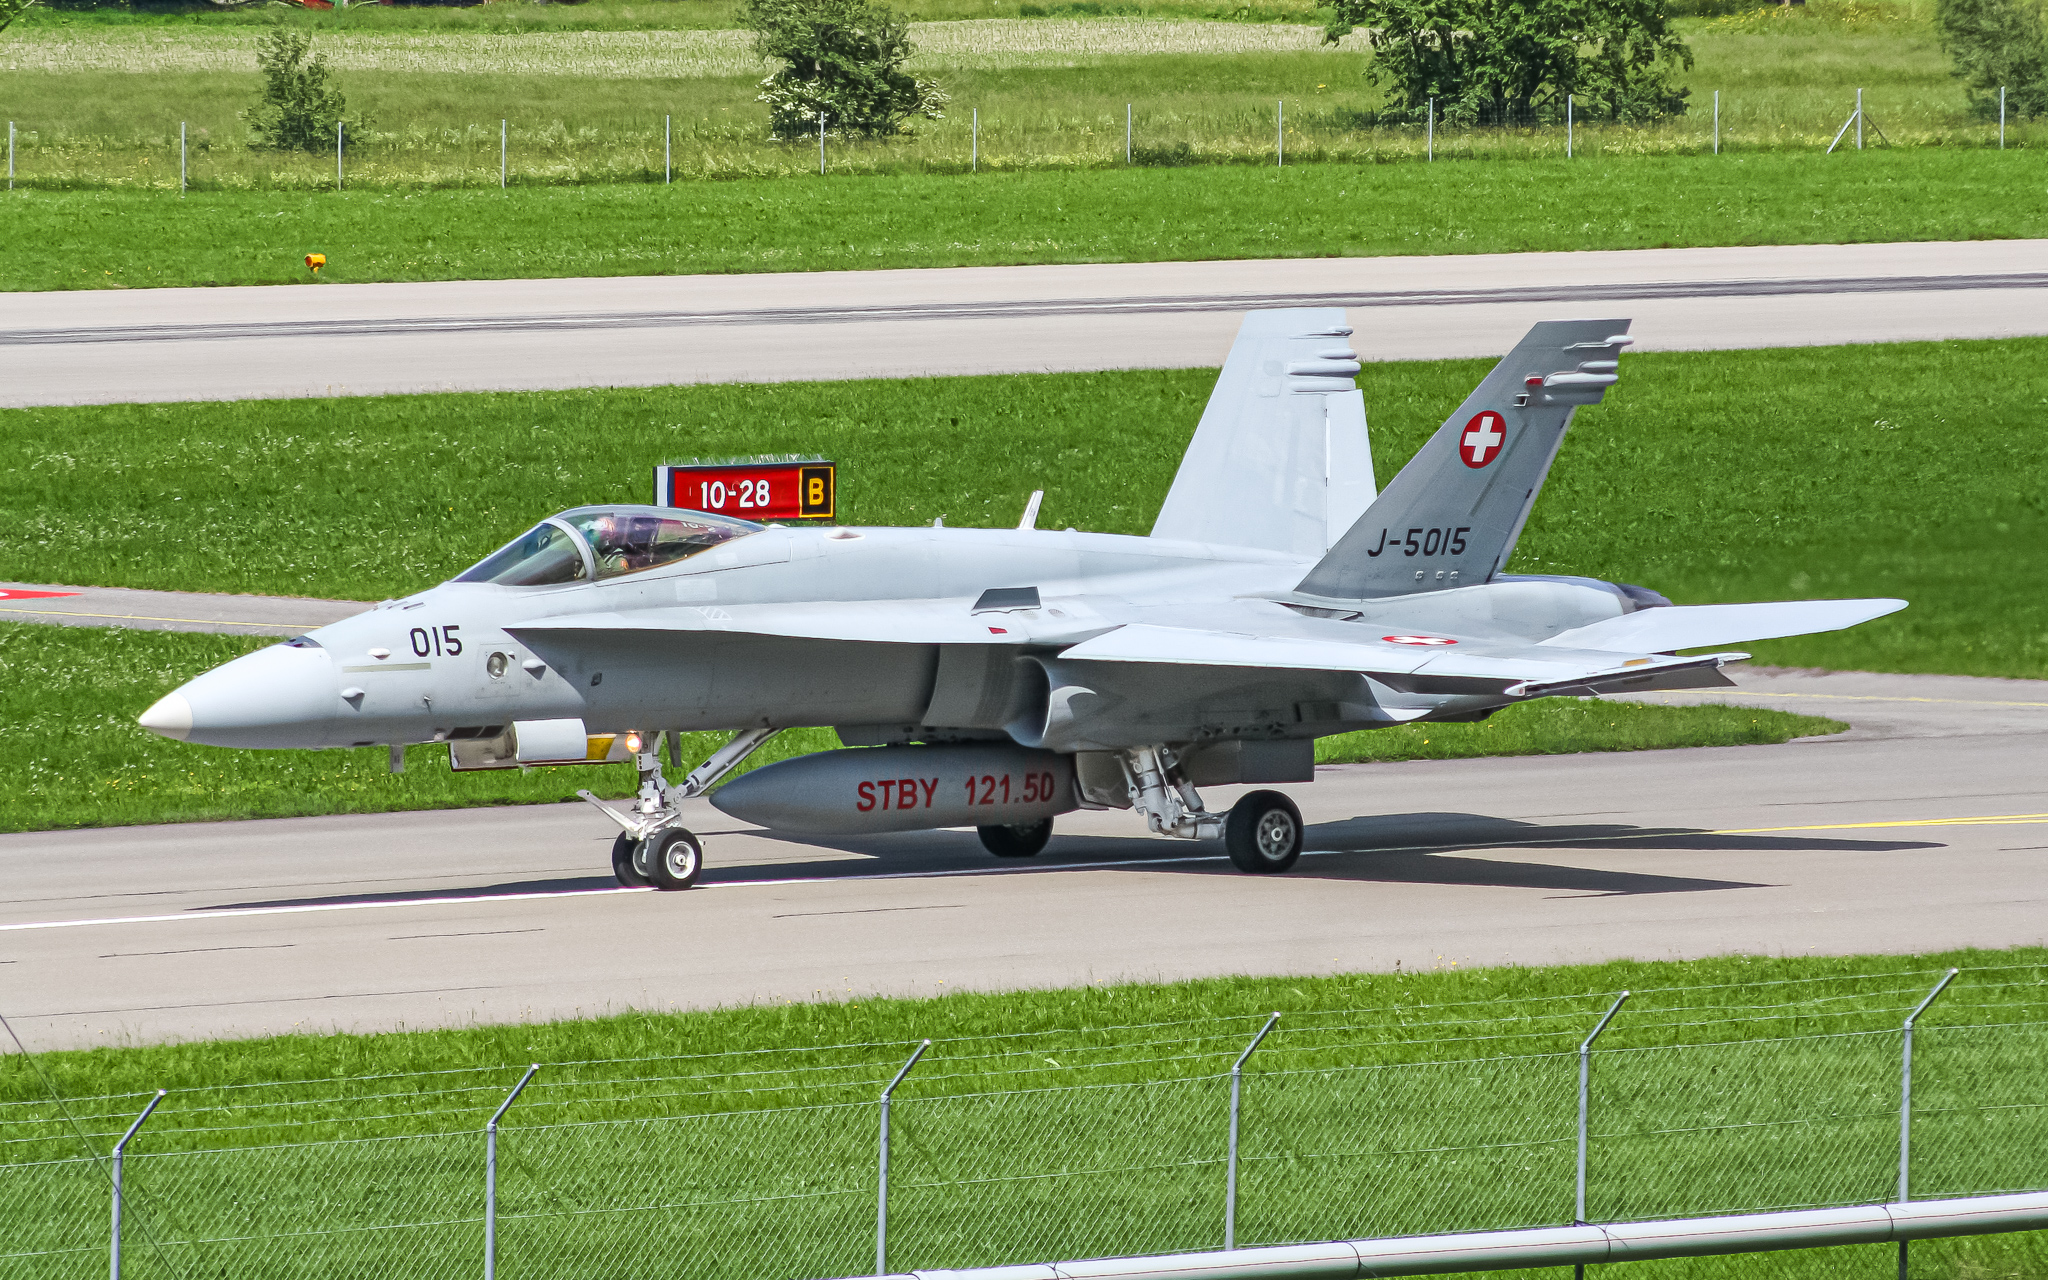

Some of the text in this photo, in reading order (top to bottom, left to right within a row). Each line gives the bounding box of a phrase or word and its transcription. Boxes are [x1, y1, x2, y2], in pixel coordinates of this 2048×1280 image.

[701, 478, 824, 509] 10-28 B
[1367, 527, 1471, 558] J-5015
[410, 625, 463, 657] 015
[856, 772, 1055, 812] STBY 121.50
